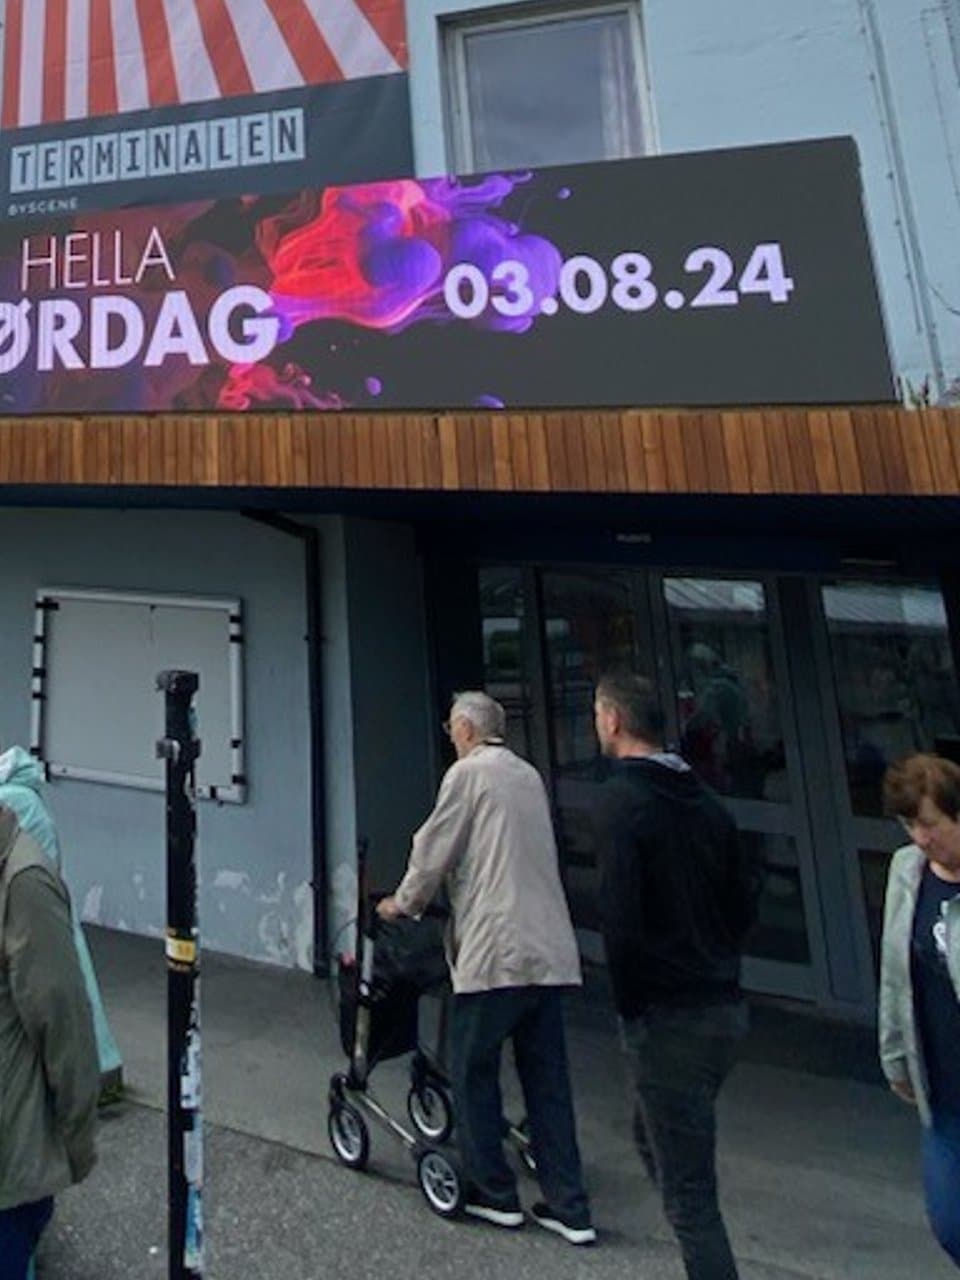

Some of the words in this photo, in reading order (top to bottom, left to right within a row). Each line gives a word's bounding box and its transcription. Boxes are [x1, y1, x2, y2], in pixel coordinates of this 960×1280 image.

[16, 113, 302, 186] TERMINALEN
[21, 226, 176, 292] HELLA
[443, 242, 794, 320] 03.08.24
